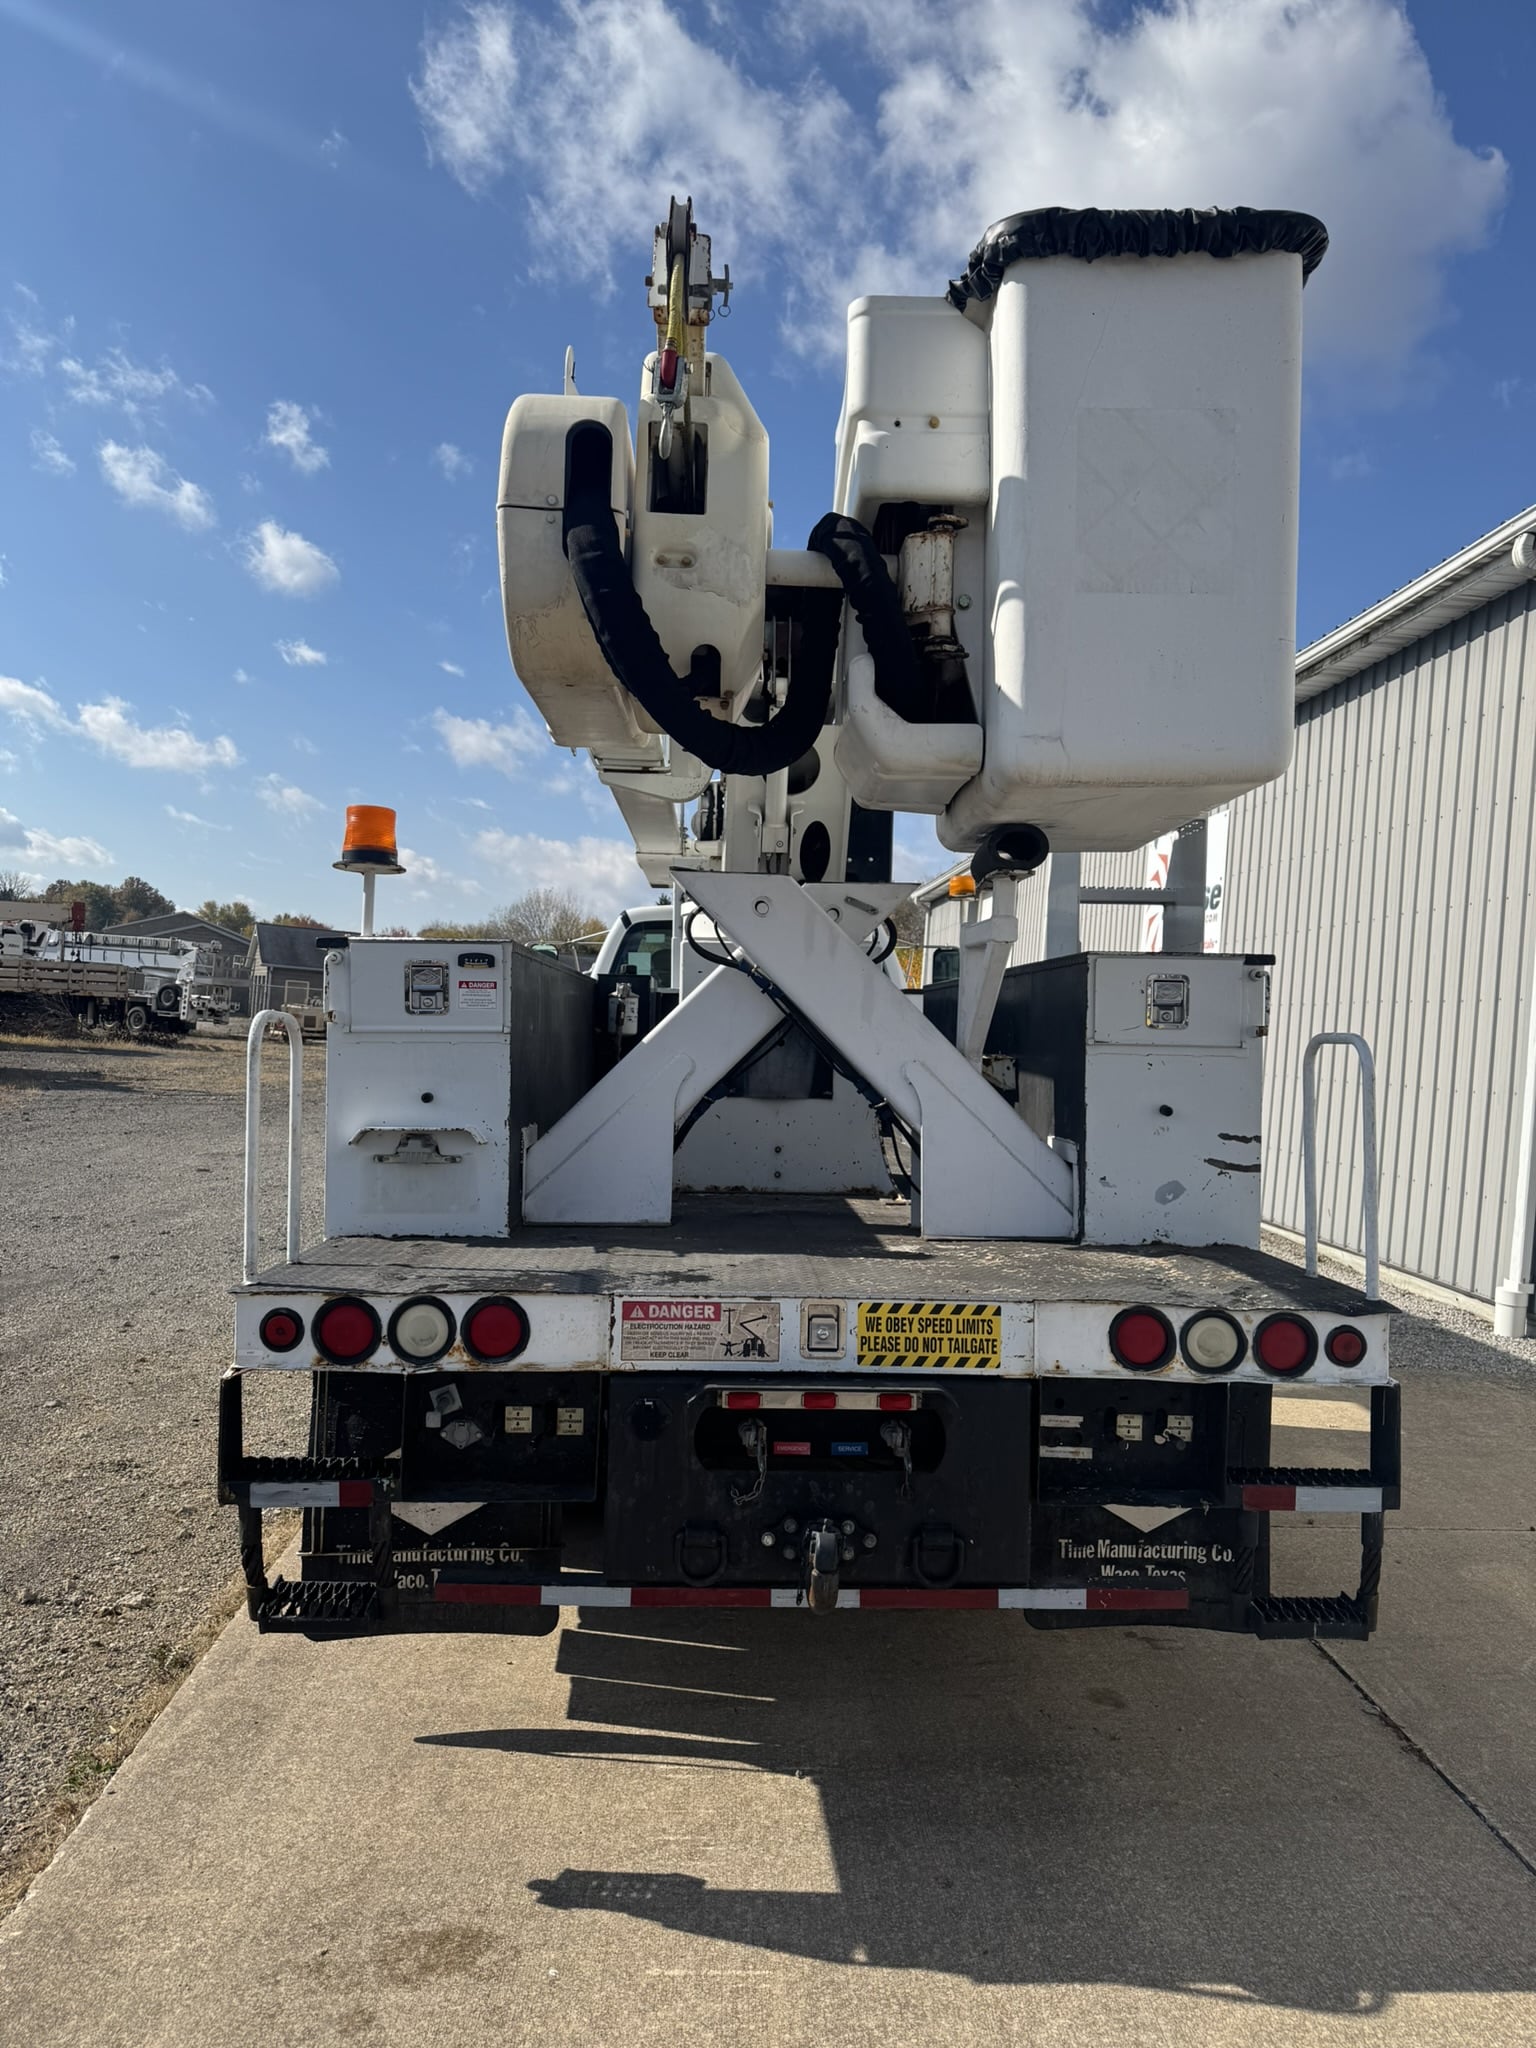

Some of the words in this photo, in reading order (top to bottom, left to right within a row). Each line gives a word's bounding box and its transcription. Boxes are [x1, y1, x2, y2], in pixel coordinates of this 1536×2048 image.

[648, 1305, 715, 1319] DANGER
[865, 1316, 882, 1332] WE
[886, 1316, 914, 1333] OBEY
[918, 1317, 952, 1334] SPEED
[956, 1318, 993, 1335] LIMITS
[860, 1335, 900, 1352] PLEASE
[904, 1336, 919, 1352] DO
[923, 1337, 944, 1353] NOT
[947, 1337, 998, 1354] TAILGATE
[392, 1541, 494, 1566] anufacturing
[498, 1542, 525, 1564] Co.
[1057, 1539, 1095, 1559] Time
[1097, 1538, 1207, 1563] Manufacturing
[1211, 1543, 1236, 1563] Co.
[393, 1569, 429, 1589] aco.
